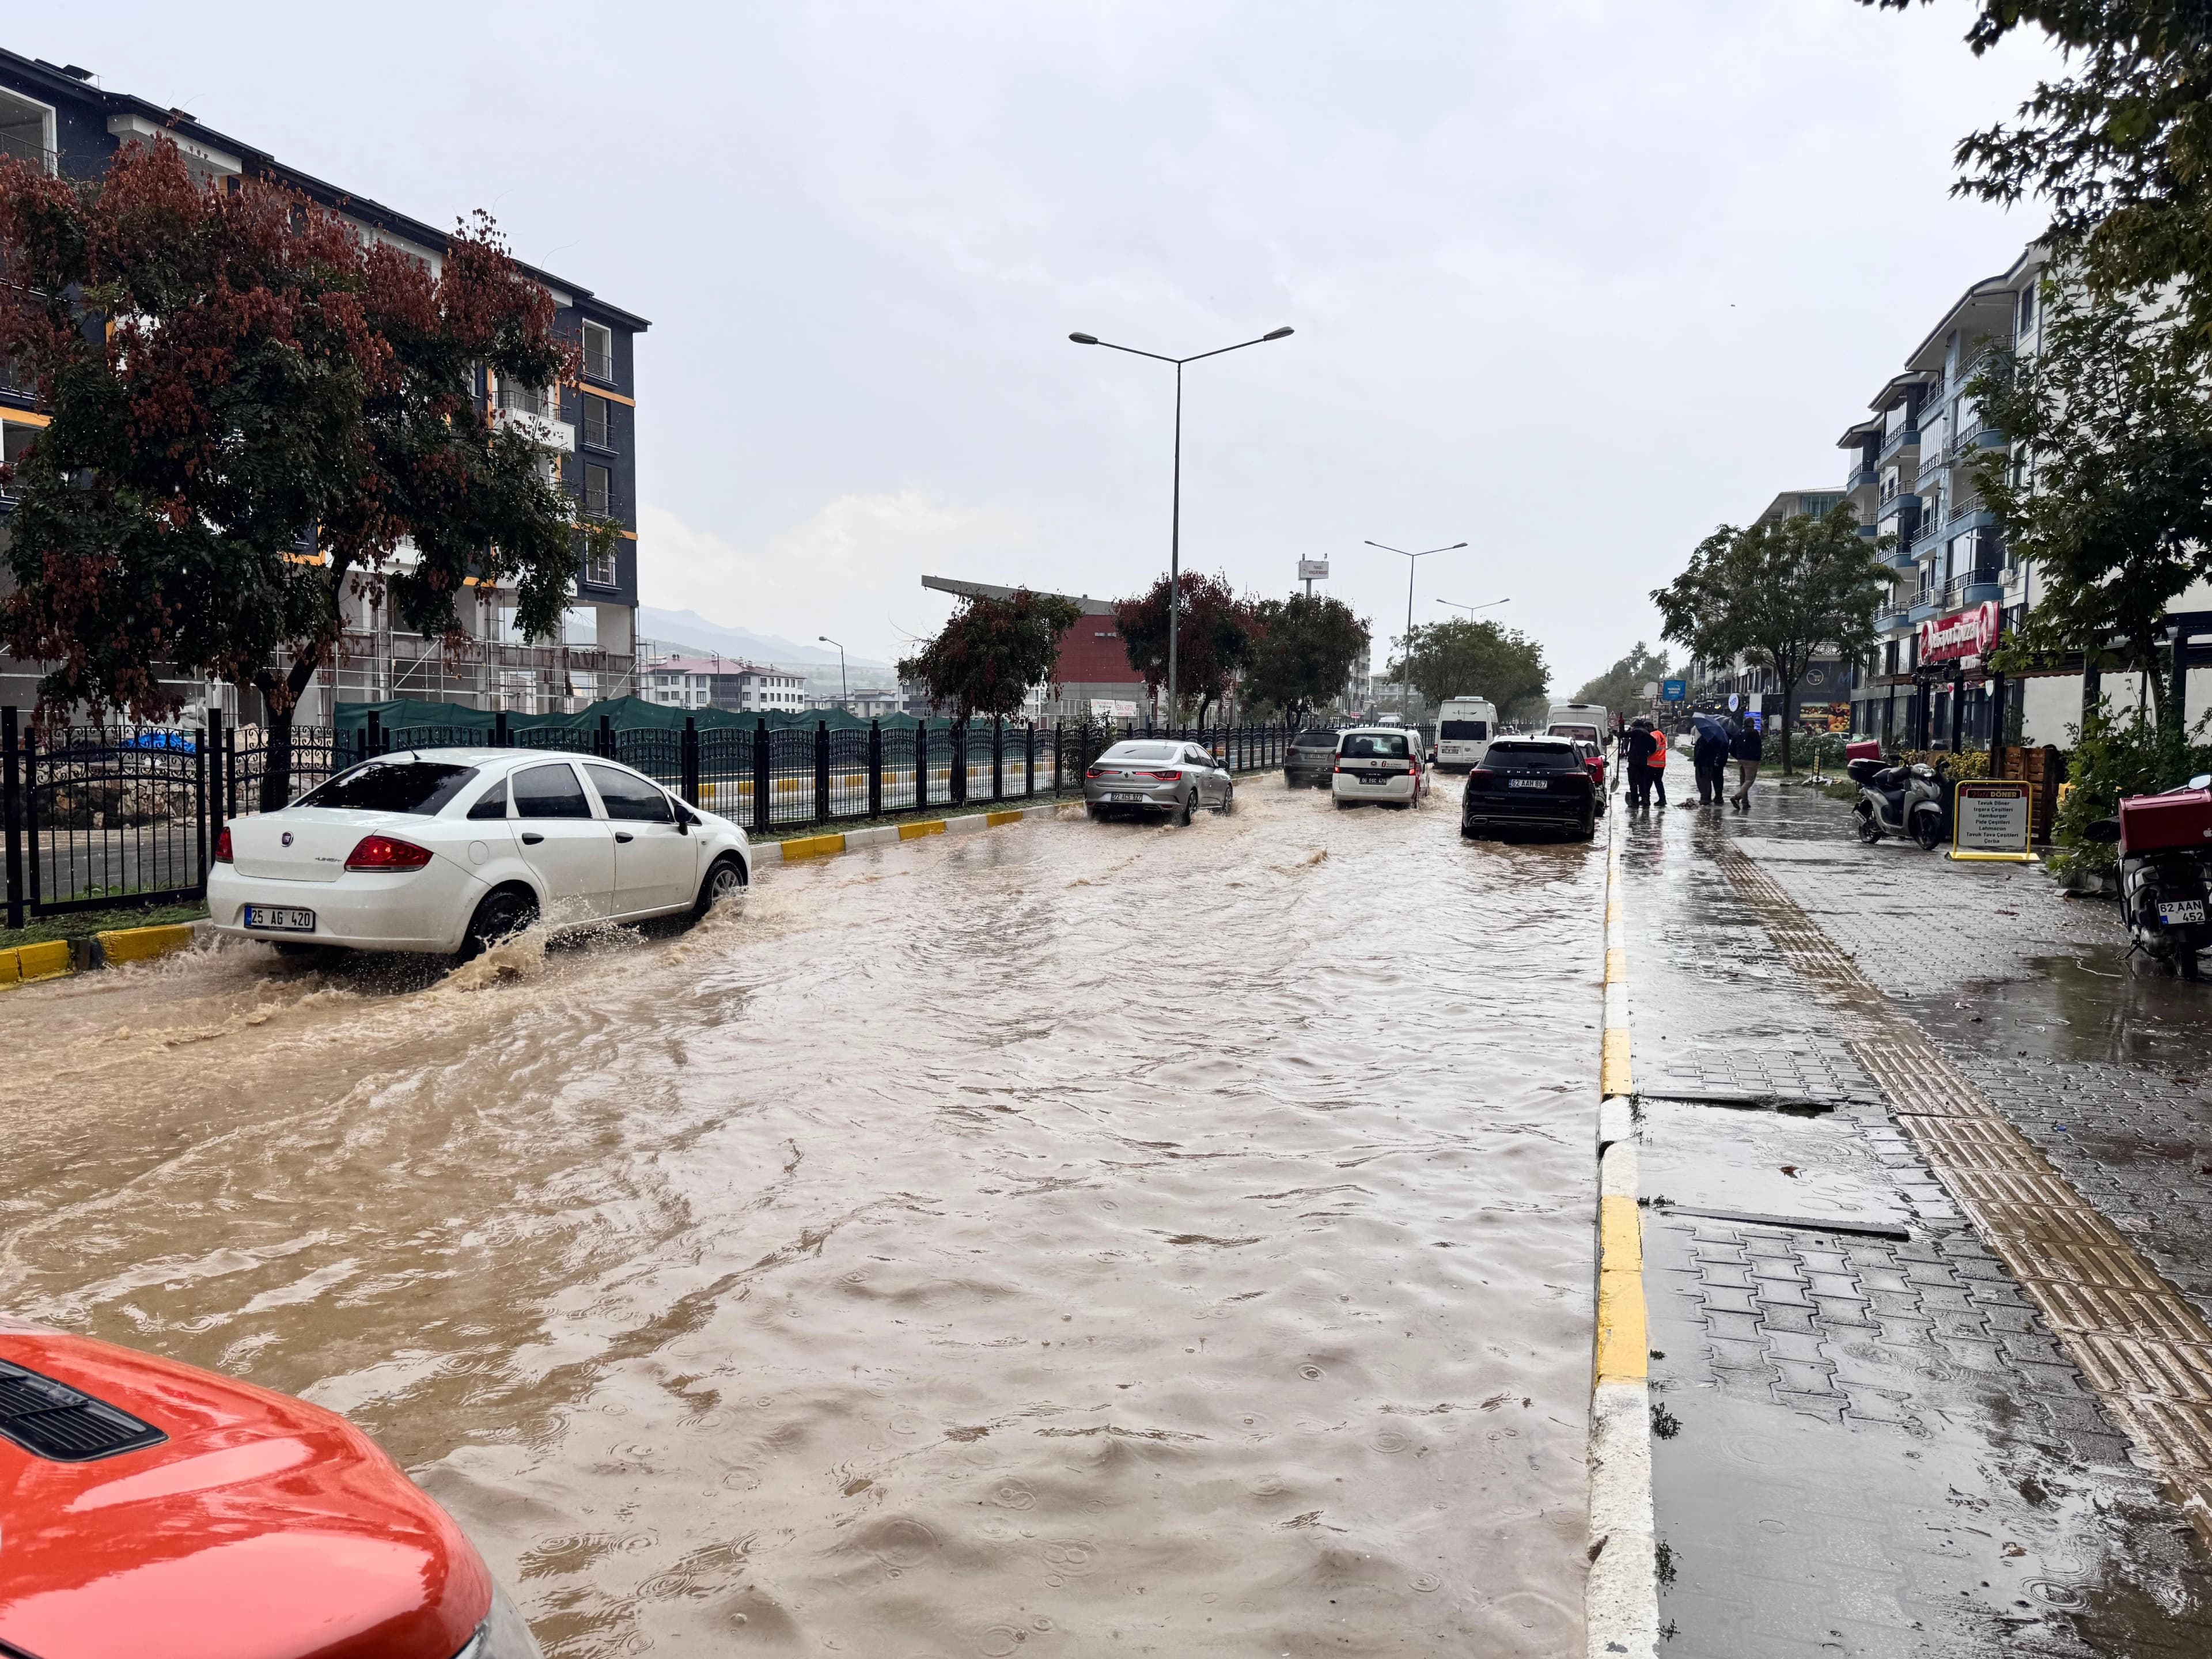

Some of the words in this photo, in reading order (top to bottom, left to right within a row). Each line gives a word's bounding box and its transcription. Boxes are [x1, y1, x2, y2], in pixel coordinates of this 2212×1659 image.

[2160, 904, 2175, 912] 62
[2177, 901, 2202, 911] AAN
[252, 910, 263, 923] 25
[271, 911, 283, 925] AG
[291, 912, 310, 926] 420
[2183, 912, 2204, 922] 452
